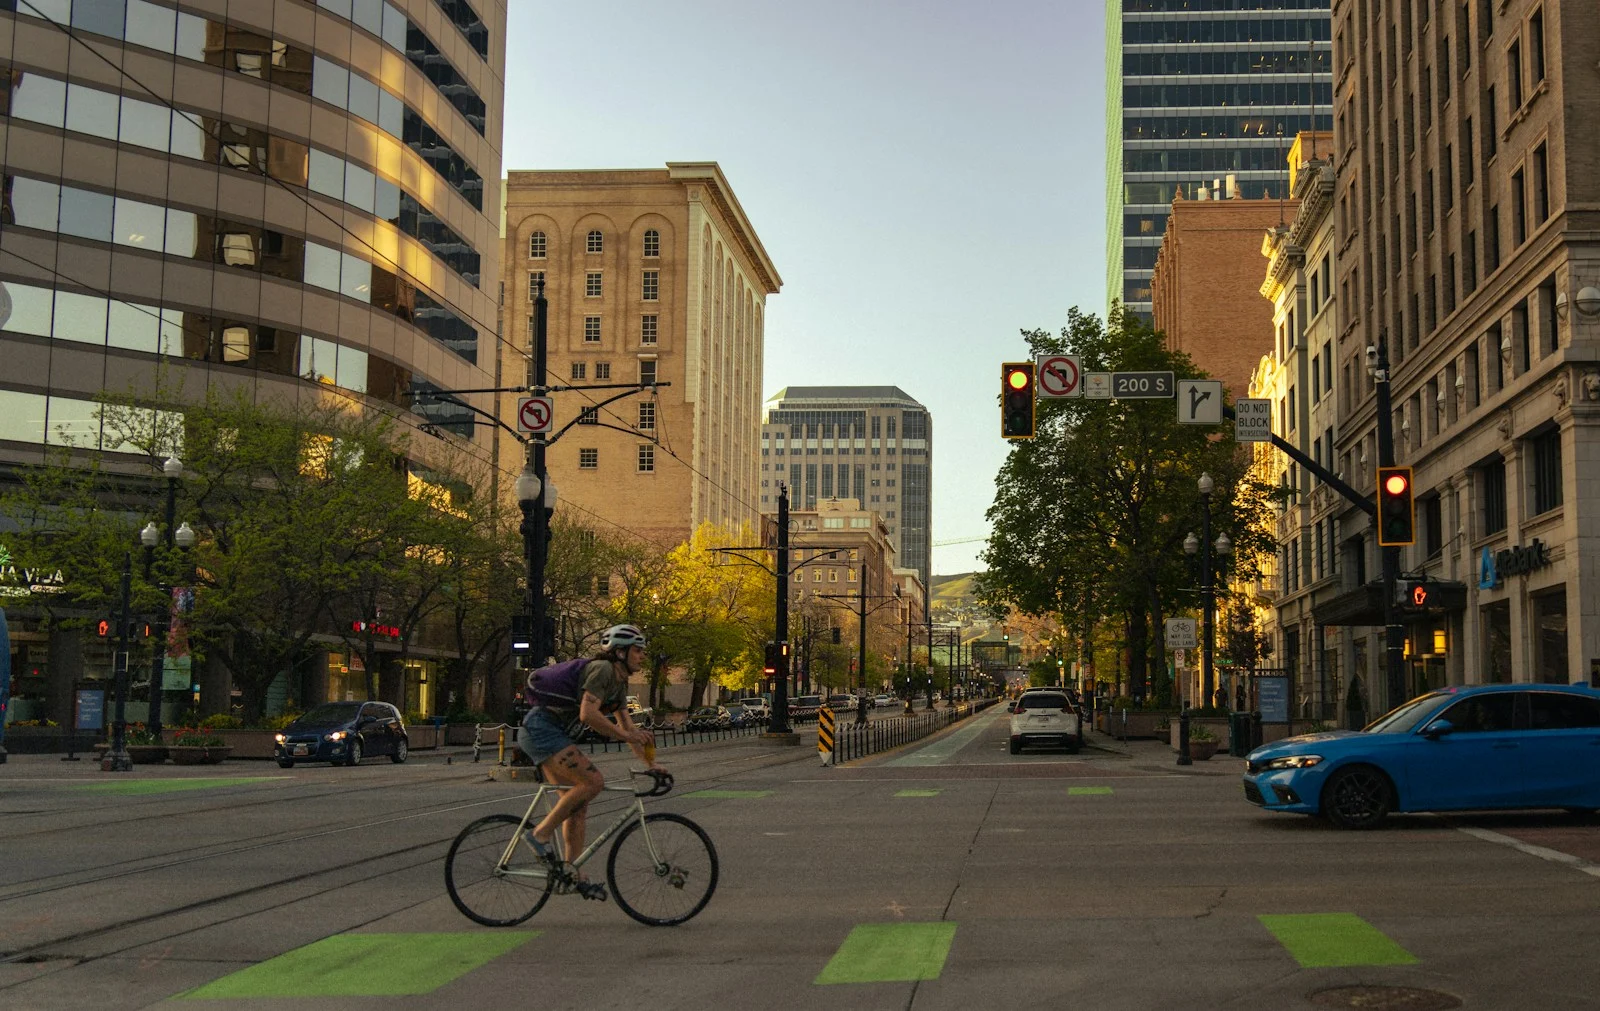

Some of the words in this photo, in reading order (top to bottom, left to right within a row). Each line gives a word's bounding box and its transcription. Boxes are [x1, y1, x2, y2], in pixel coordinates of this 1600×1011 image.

[1118, 378, 1149, 392] 200
[1156, 378, 1167, 392] S.
[1239, 403, 1250, 413] DO
[1253, 403, 1268, 413] NOT
[1239, 417, 1268, 427] BLOCK
